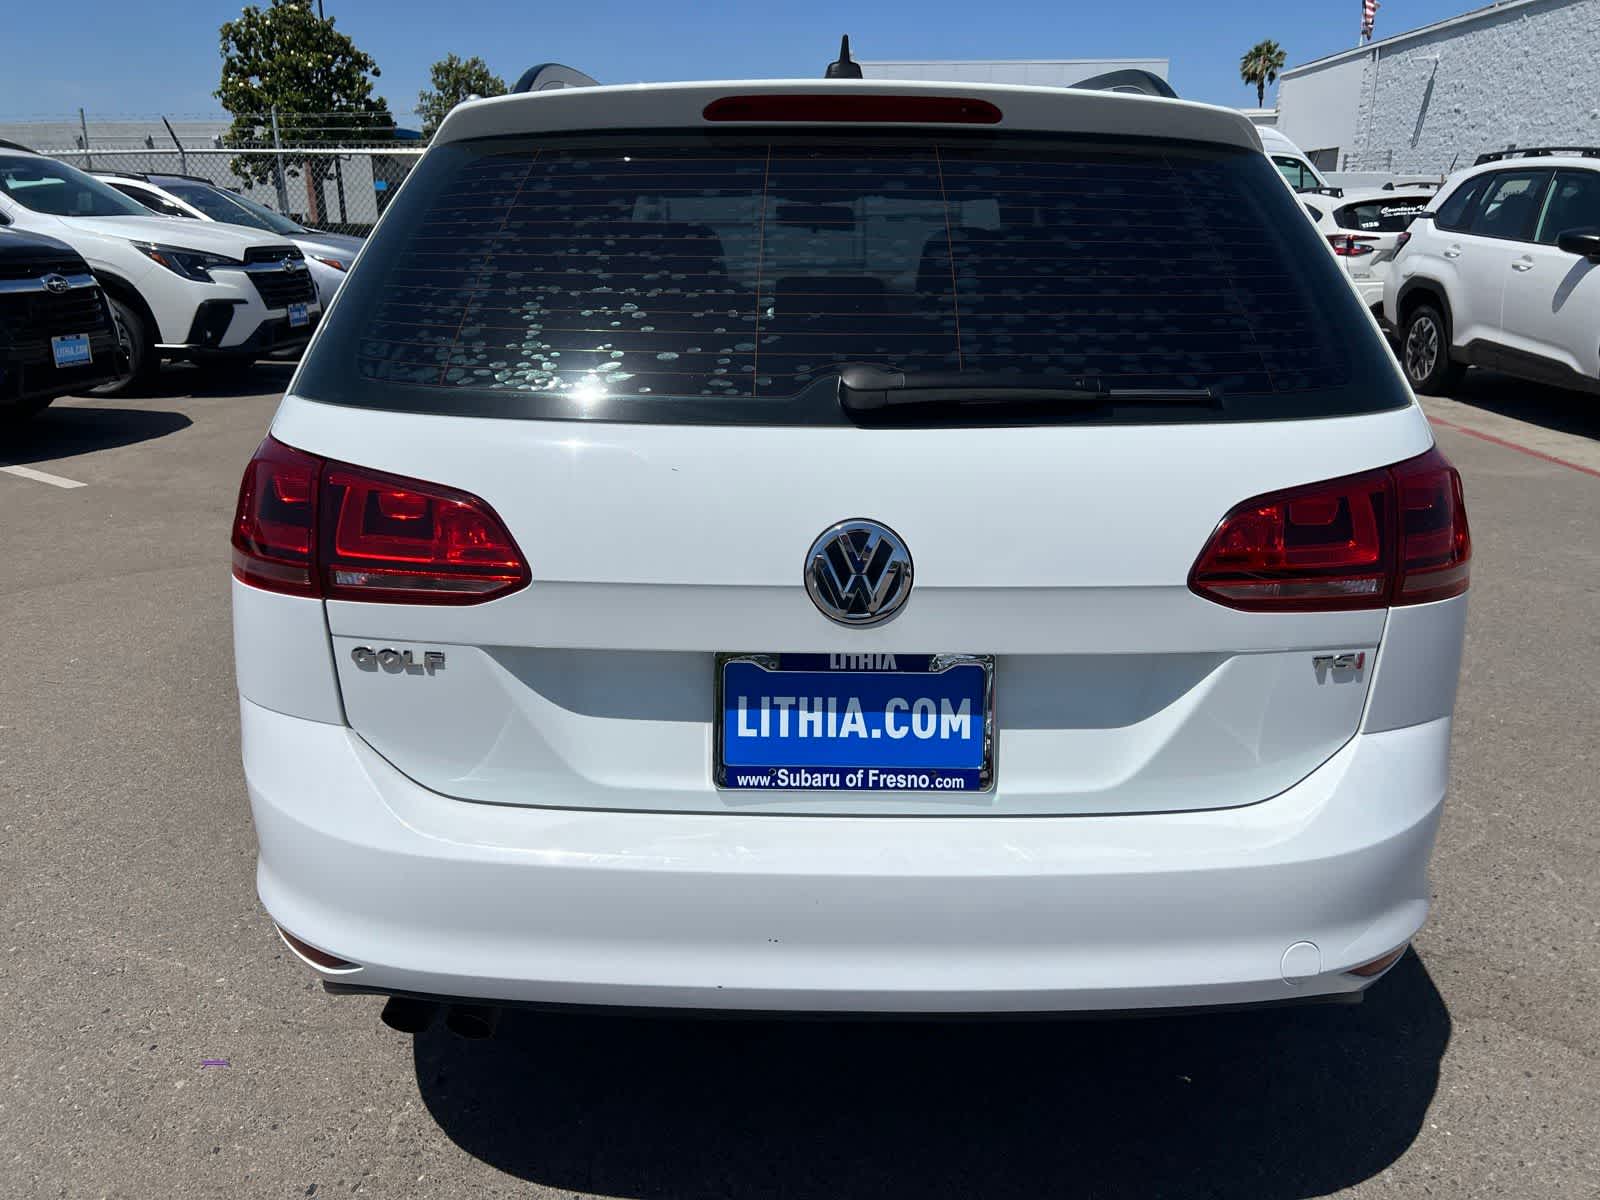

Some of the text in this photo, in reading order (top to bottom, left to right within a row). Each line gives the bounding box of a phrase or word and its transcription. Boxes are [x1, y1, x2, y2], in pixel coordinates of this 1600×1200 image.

[351, 646, 446, 674] GOLF
[829, 653, 897, 670] LITHIA
[737, 696, 971, 740] LITHIA.COM
[737, 768, 965, 789] www.Subaru of Fresno.com
